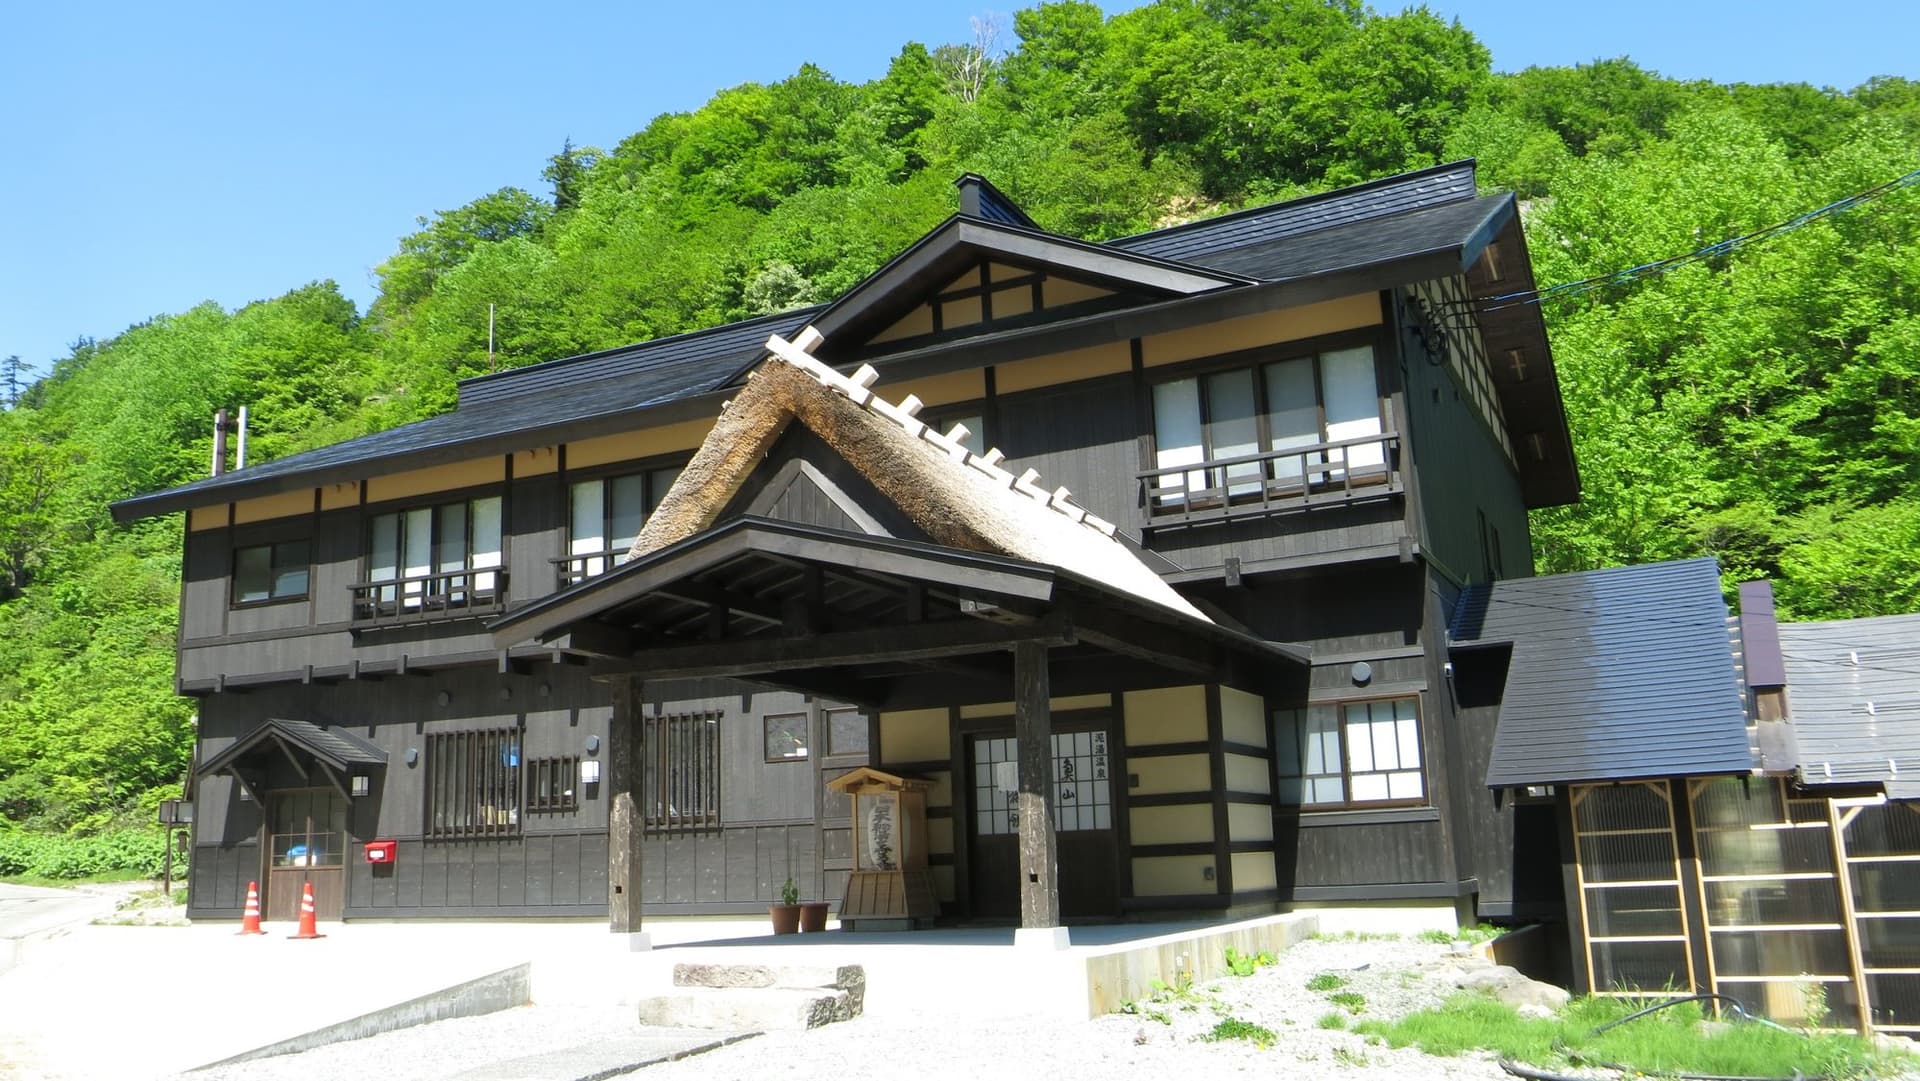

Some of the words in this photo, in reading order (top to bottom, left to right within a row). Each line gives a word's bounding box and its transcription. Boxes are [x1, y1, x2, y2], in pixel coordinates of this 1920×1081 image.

[1094, 732, 1106, 778] 泥湯温泉
[1062, 757, 1075, 799] 奥山
